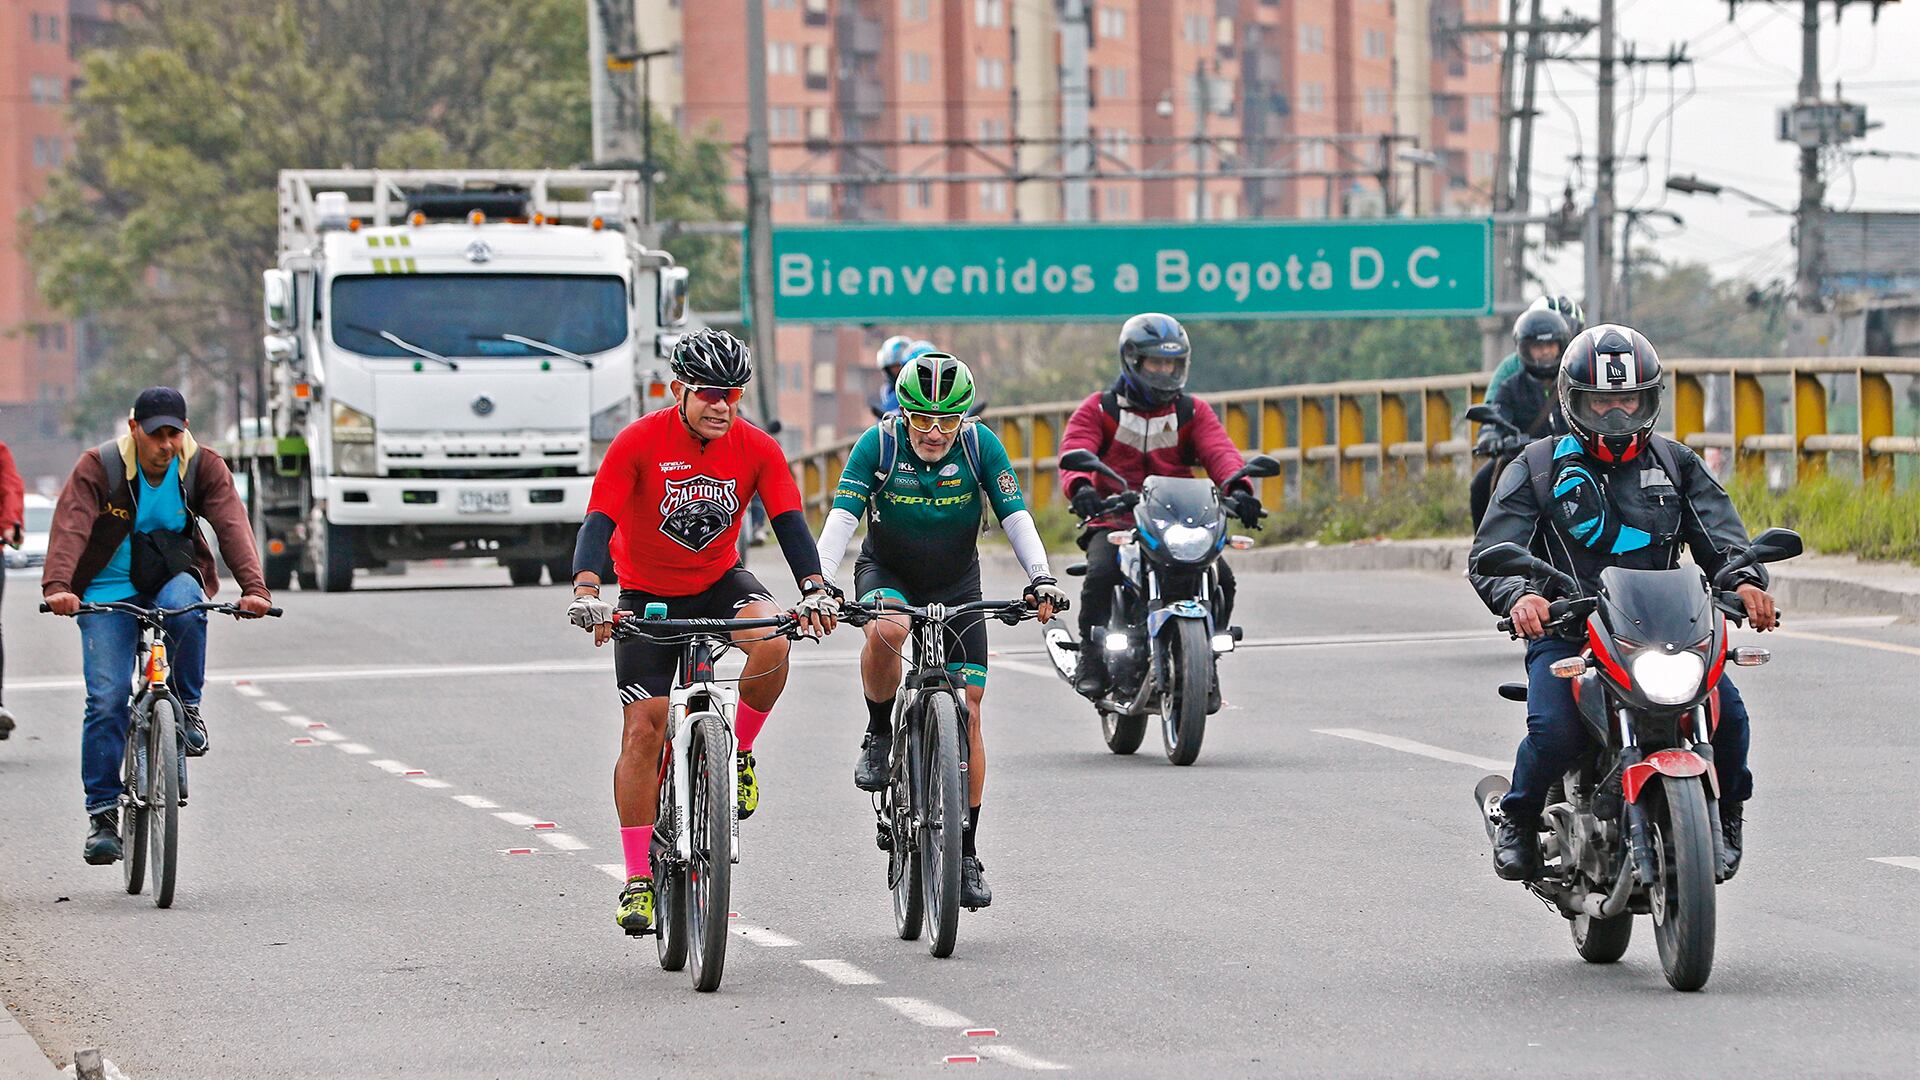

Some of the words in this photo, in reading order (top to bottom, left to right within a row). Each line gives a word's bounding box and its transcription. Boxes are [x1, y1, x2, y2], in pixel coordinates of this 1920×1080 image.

[779, 252, 1095, 297] Bienvenidos
[1114, 263, 1139, 293] a
[1156, 249, 1333, 302] Bogotá
[1350, 247, 1458, 291] D.C.
[662, 482, 736, 514] RAPTORS
[687, 617, 726, 626] CANYON
